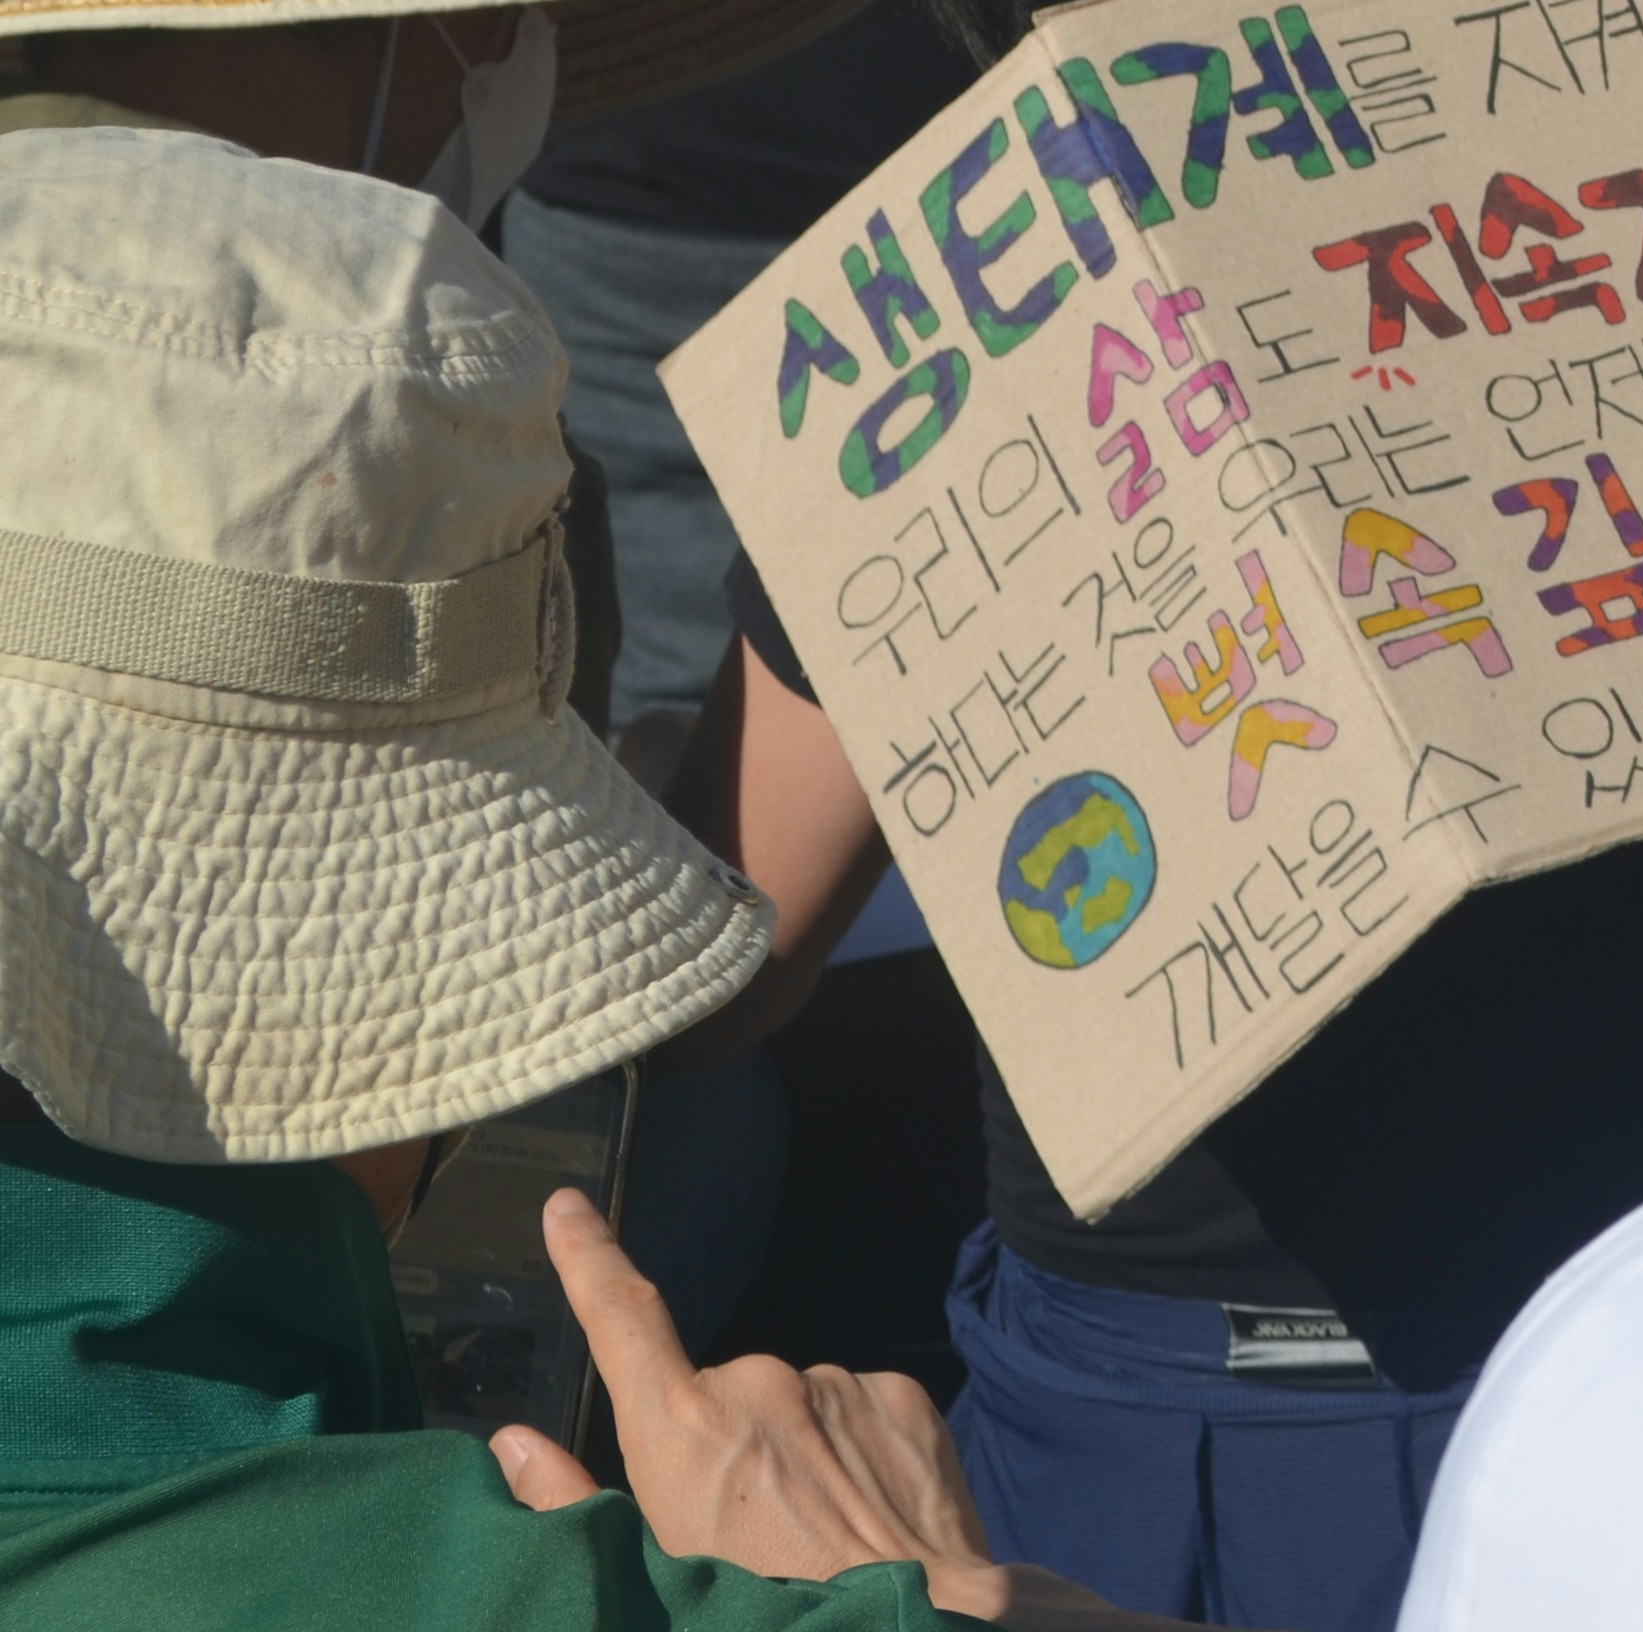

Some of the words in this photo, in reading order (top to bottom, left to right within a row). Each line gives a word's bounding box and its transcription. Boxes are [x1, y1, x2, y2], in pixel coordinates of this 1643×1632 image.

[777, 4, 1447, 499] 생태계를
[837, 414, 1081, 675] 우리의
[883, 642, 1087, 836] 하다는
[1062, 517, 1208, 677] 것을
[1217, 405, 1471, 543] 우리는
[1403, 745, 1521, 843] 수
